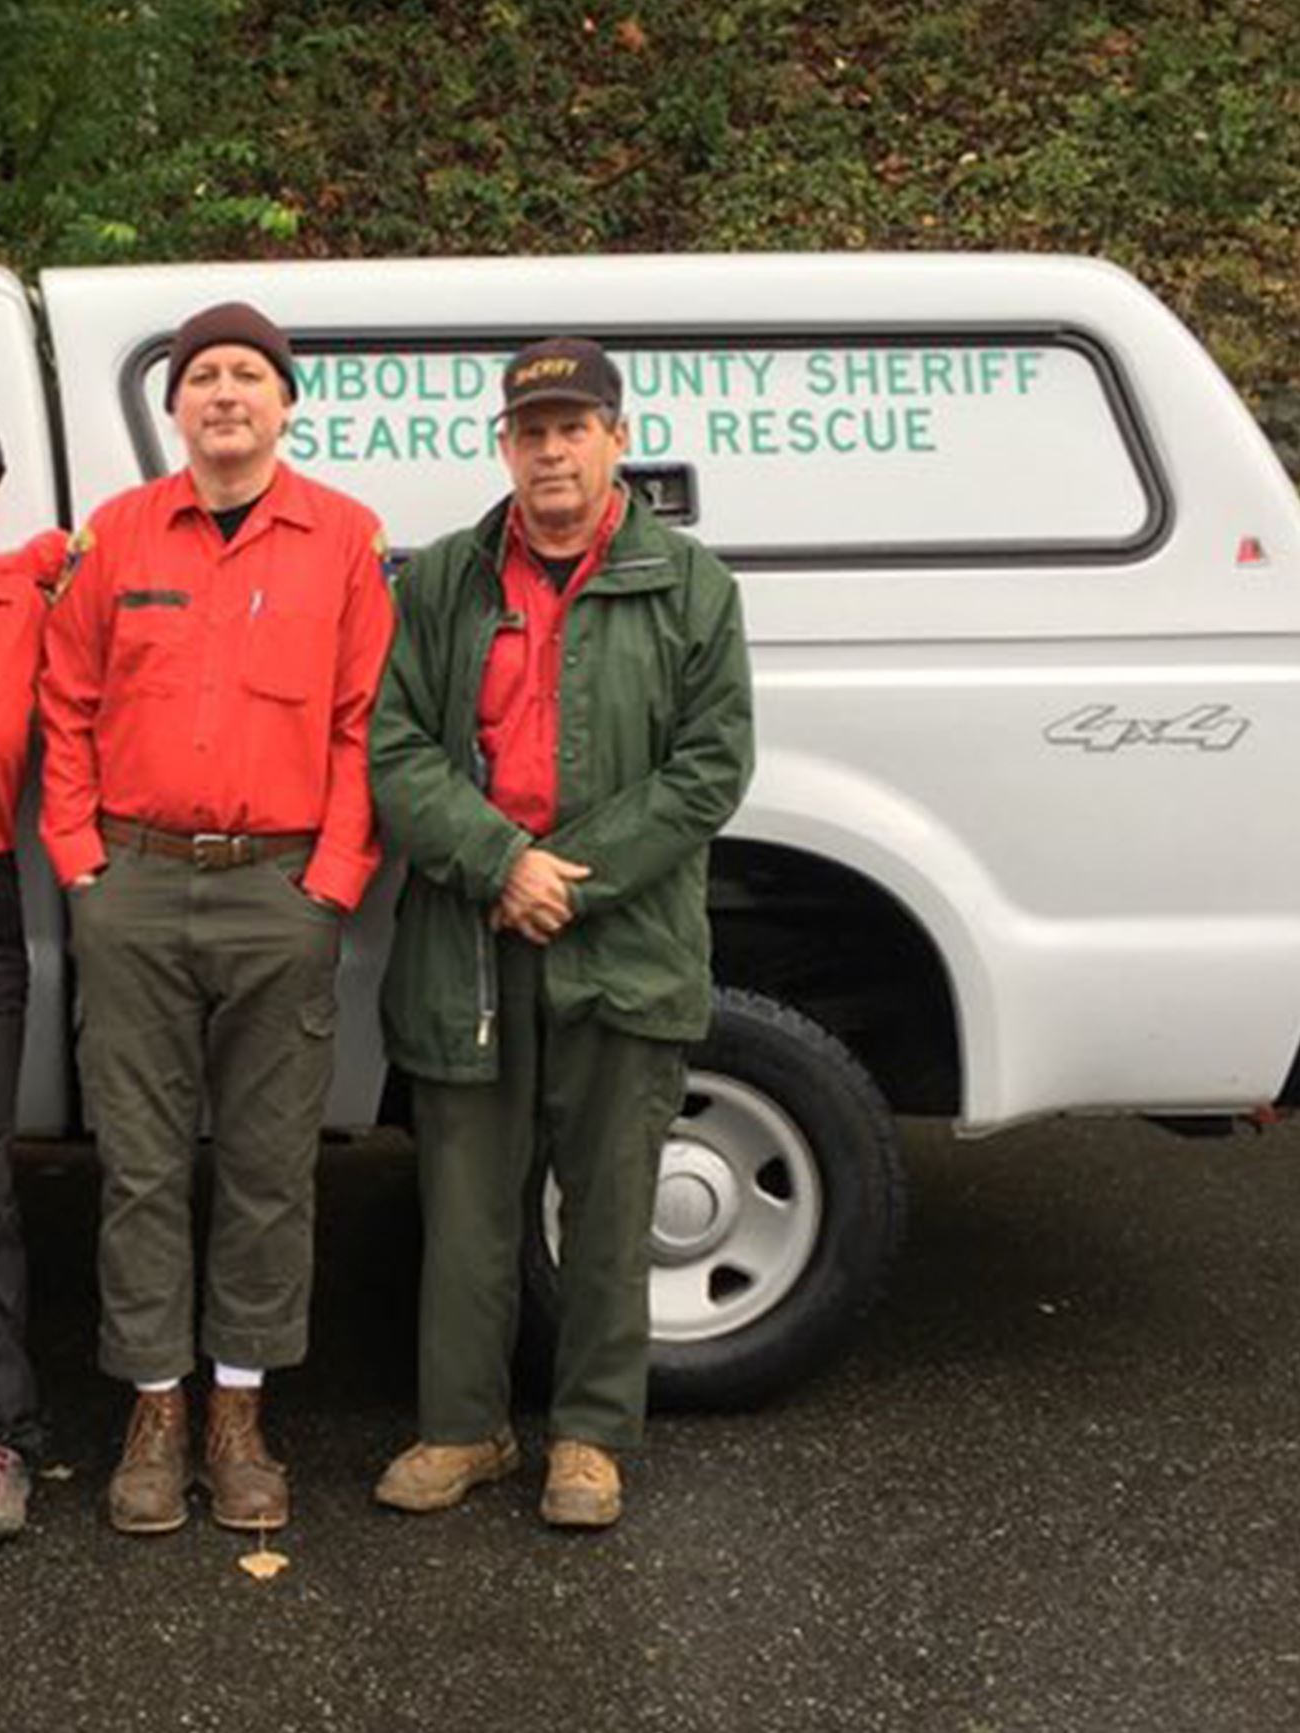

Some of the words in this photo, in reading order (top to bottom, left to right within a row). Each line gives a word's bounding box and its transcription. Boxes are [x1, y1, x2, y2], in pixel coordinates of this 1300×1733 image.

[293, 357, 508, 400] MBOLD
[630, 353, 775, 397] UNTY
[806, 351, 1043, 396] SHERIFF
[708, 408, 936, 454] RESCUE
[1043, 704, 1251, 752] 4x4
